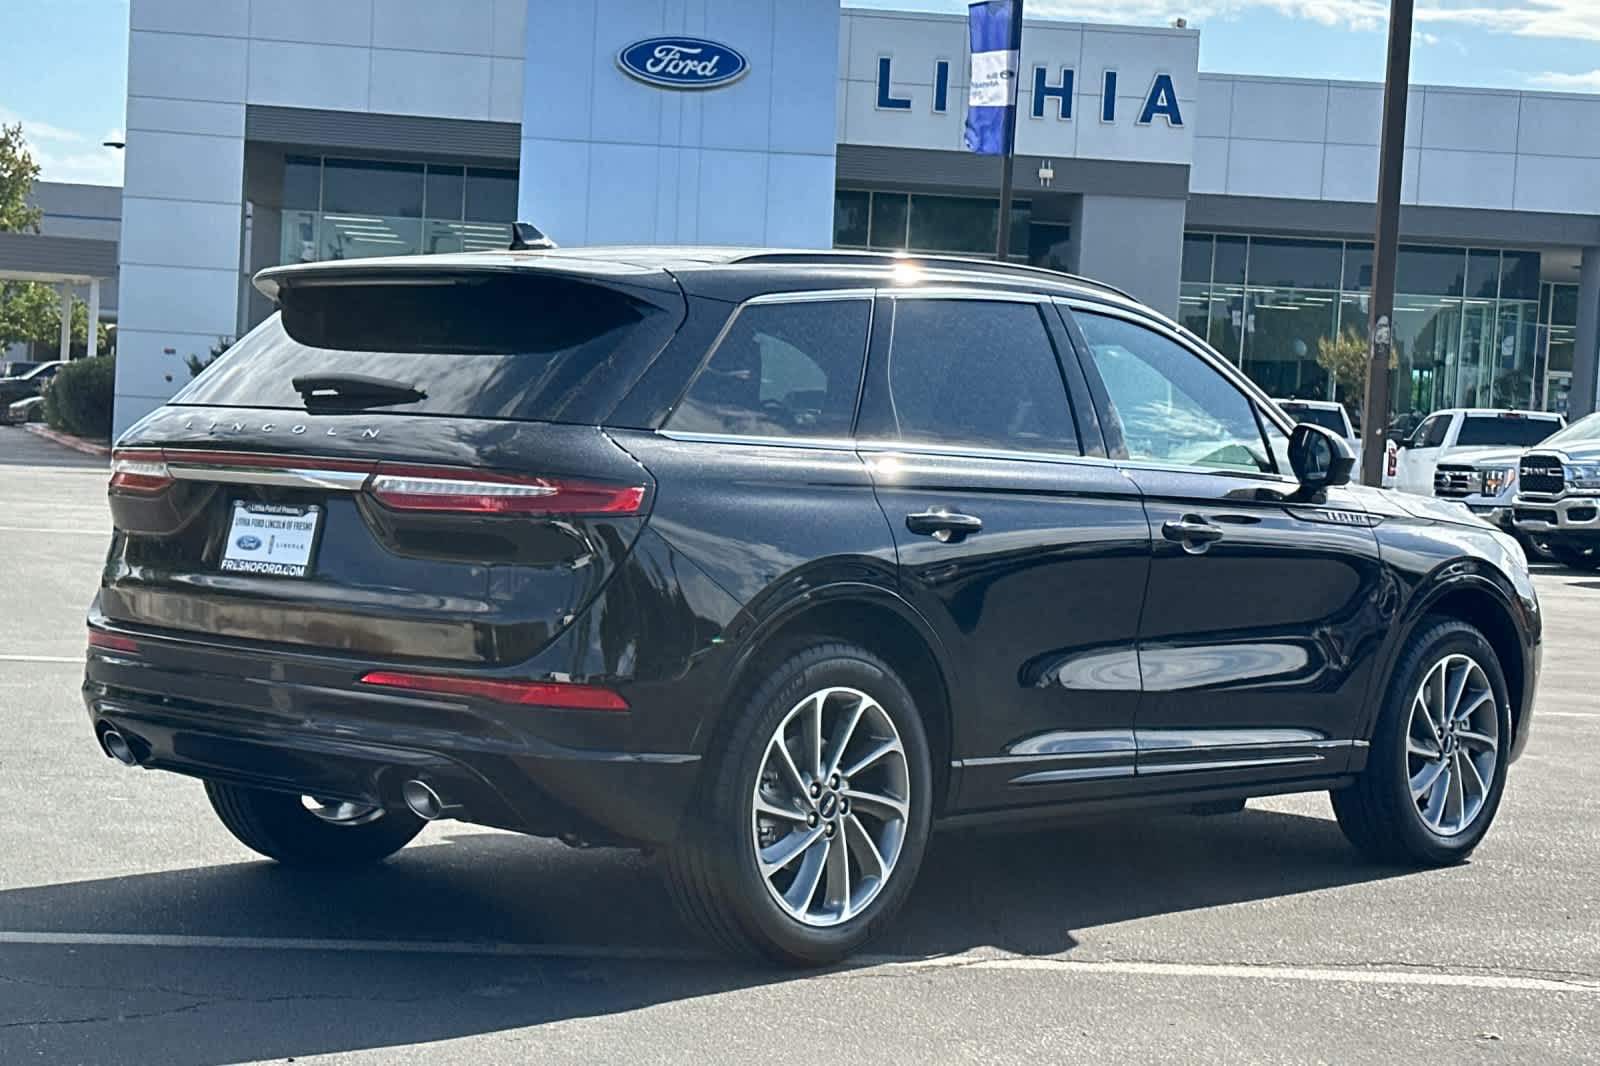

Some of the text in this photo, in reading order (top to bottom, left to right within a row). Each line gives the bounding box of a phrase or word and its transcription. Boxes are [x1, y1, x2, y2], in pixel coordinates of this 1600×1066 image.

[645, 44, 720, 76] Ford
[874, 55, 1185, 128] LIHIA
[184, 421, 380, 439] LINCOLN
[251, 519, 264, 528] FORD
[265, 520, 285, 529] LINCOLN
[286, 521, 293, 530] OF
[294, 521, 312, 531] FRESNO
